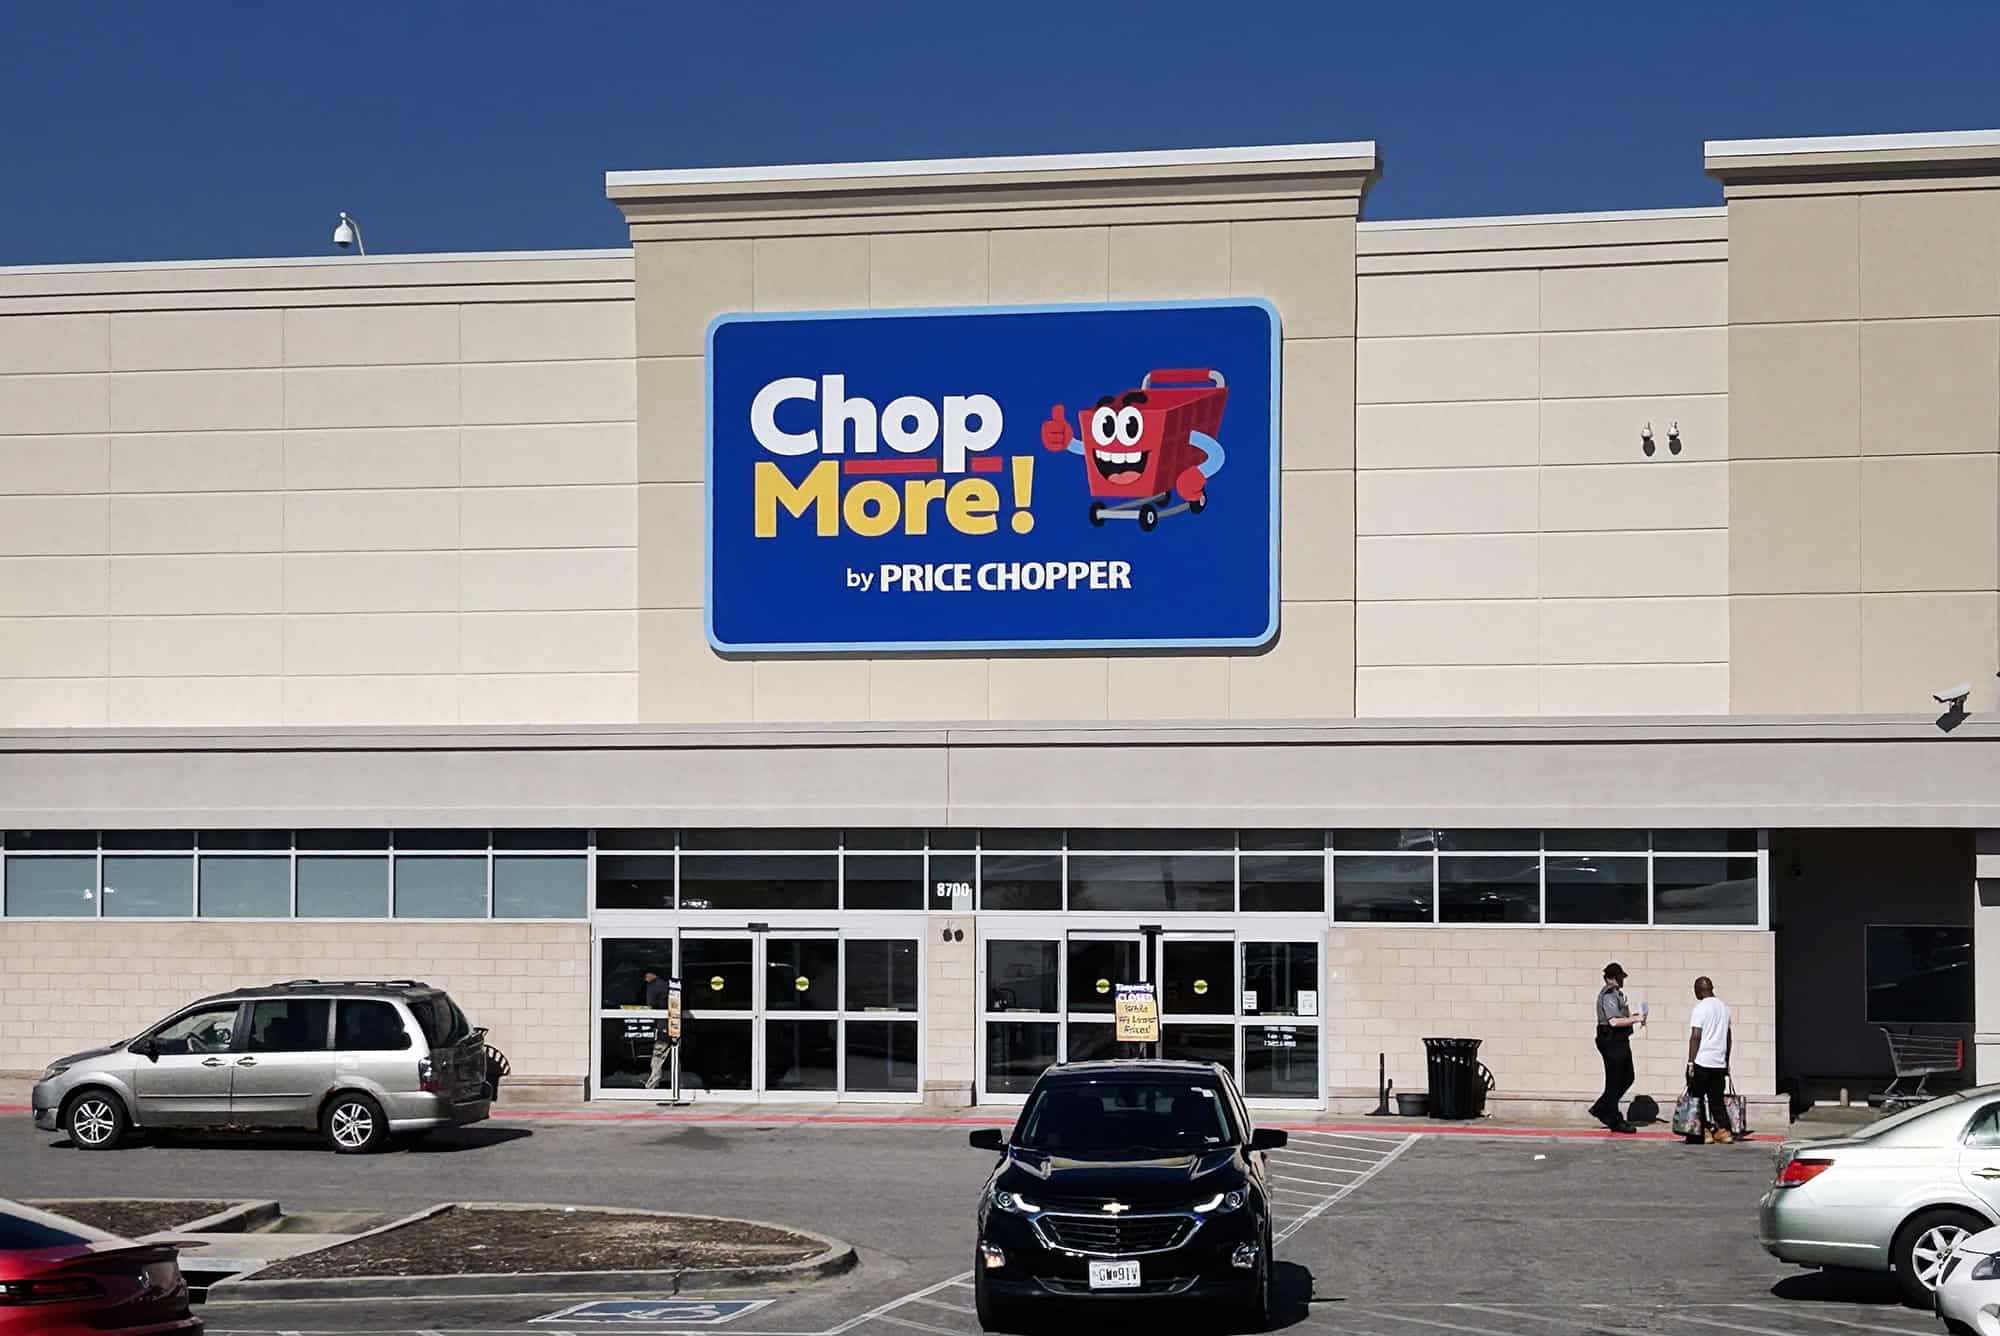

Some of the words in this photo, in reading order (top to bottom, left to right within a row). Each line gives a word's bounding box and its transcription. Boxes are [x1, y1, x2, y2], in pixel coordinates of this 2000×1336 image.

[750, 374, 1003, 474] Chop
[754, 456, 1035, 537] More!
[847, 567, 875, 592] by
[880, 563, 972, 592] PRICE
[977, 561, 1132, 591] CHOPPER
[937, 882, 969, 897] 8700
